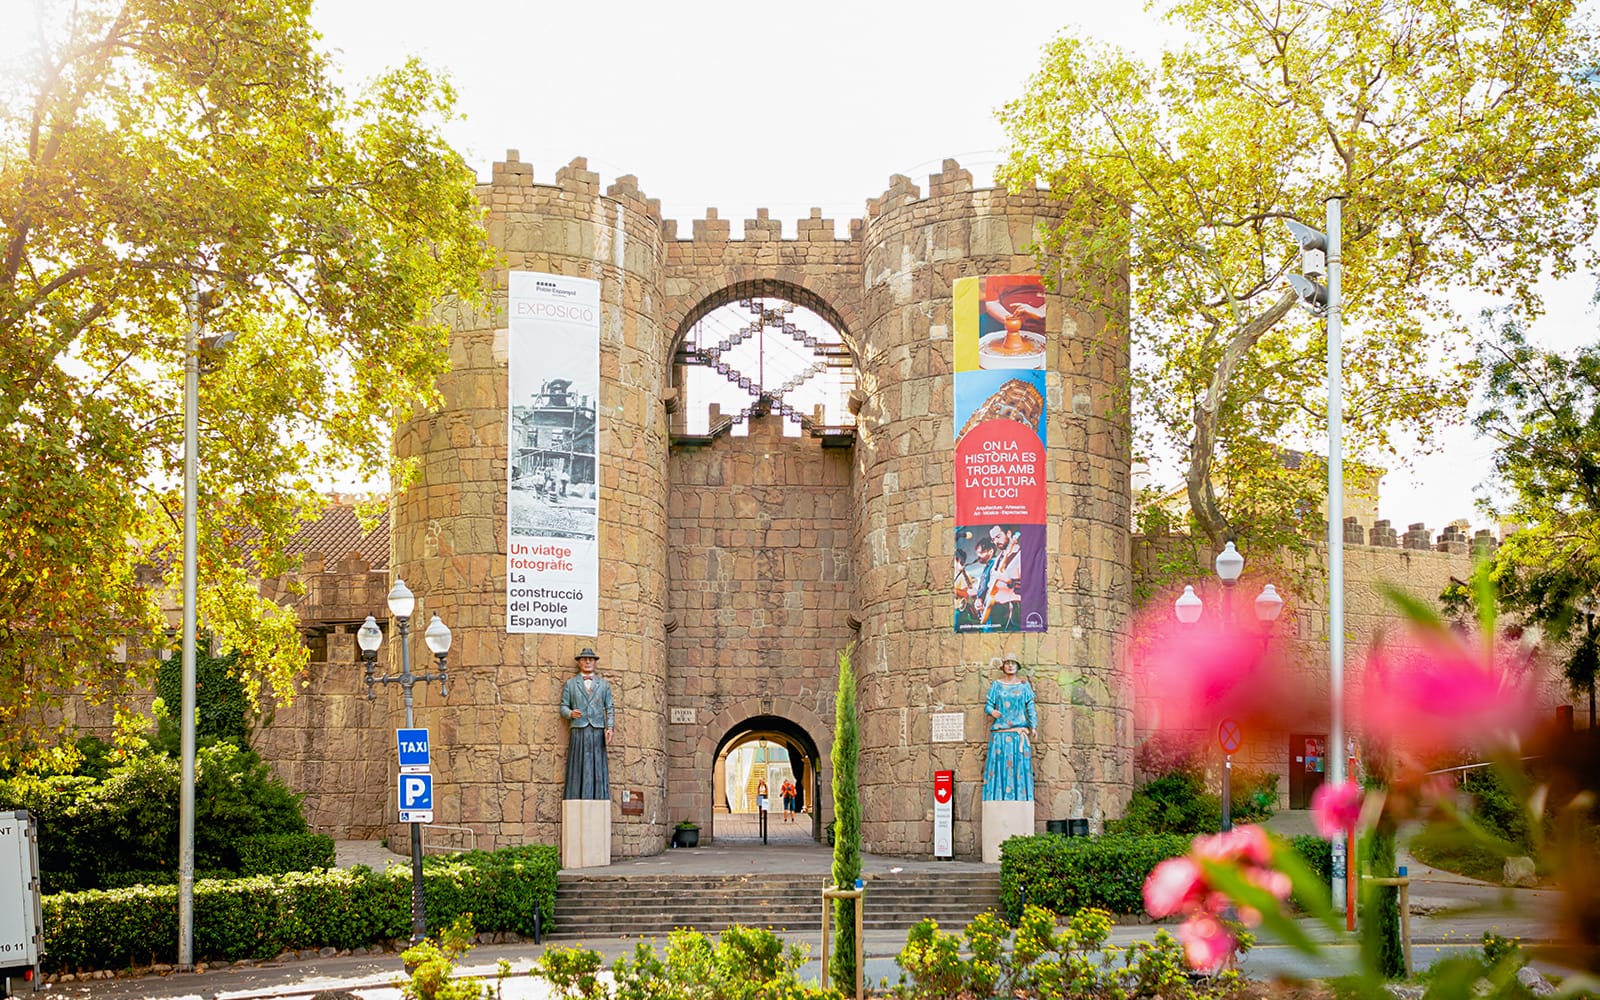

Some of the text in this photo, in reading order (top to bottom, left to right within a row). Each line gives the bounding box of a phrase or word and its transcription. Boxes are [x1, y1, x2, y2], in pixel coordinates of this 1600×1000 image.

[517, 302, 594, 322] EXPOSICIÓ
[983, 440, 1018, 451] ON LA
[964, 451, 1037, 464] HISTÒRIA ES
[966, 464, 1035, 476] TROBA AMB
[965, 476, 1037, 488] LA CULTURA
[988, 488, 1018, 498] L'OCI
[510, 543, 572, 558] Un viatge
[510, 558, 573, 572] fotogràfic
[510, 572, 526, 583] La
[510, 587, 583, 600] construcció
[510, 601, 568, 613] del Poble
[510, 615, 567, 629] Espanyol
[400, 741, 427, 753] TAXI
[405, 778, 426, 806] P
[14, 943, 24, 951] 11
